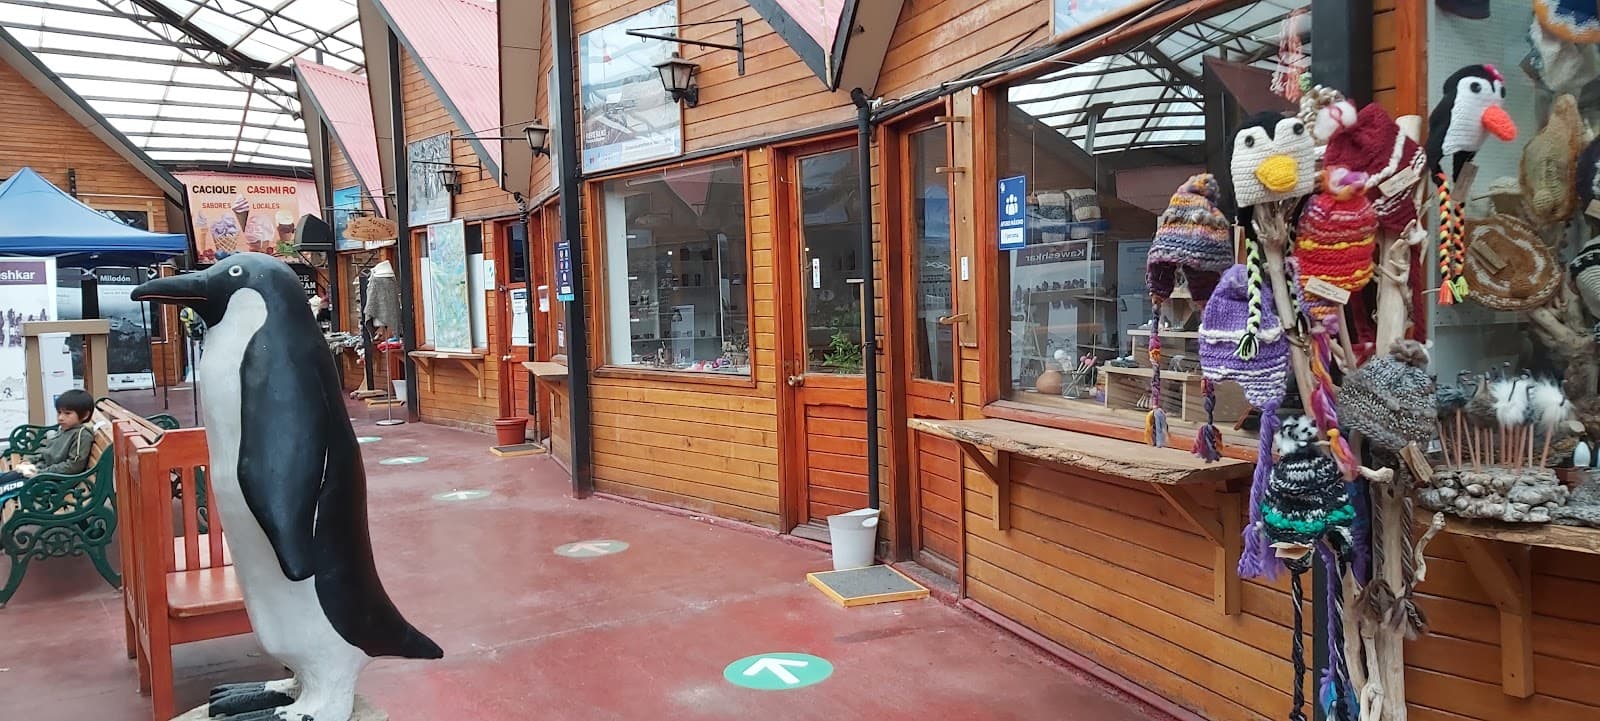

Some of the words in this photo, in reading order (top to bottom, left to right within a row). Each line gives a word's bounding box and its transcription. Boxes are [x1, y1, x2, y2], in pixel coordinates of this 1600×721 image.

[192, 185, 237, 194] CACIQUE
[246, 185, 296, 195] CASIMIRO
[0, 270, 35, 280] shkar
[100, 274, 131, 282] Milodón
